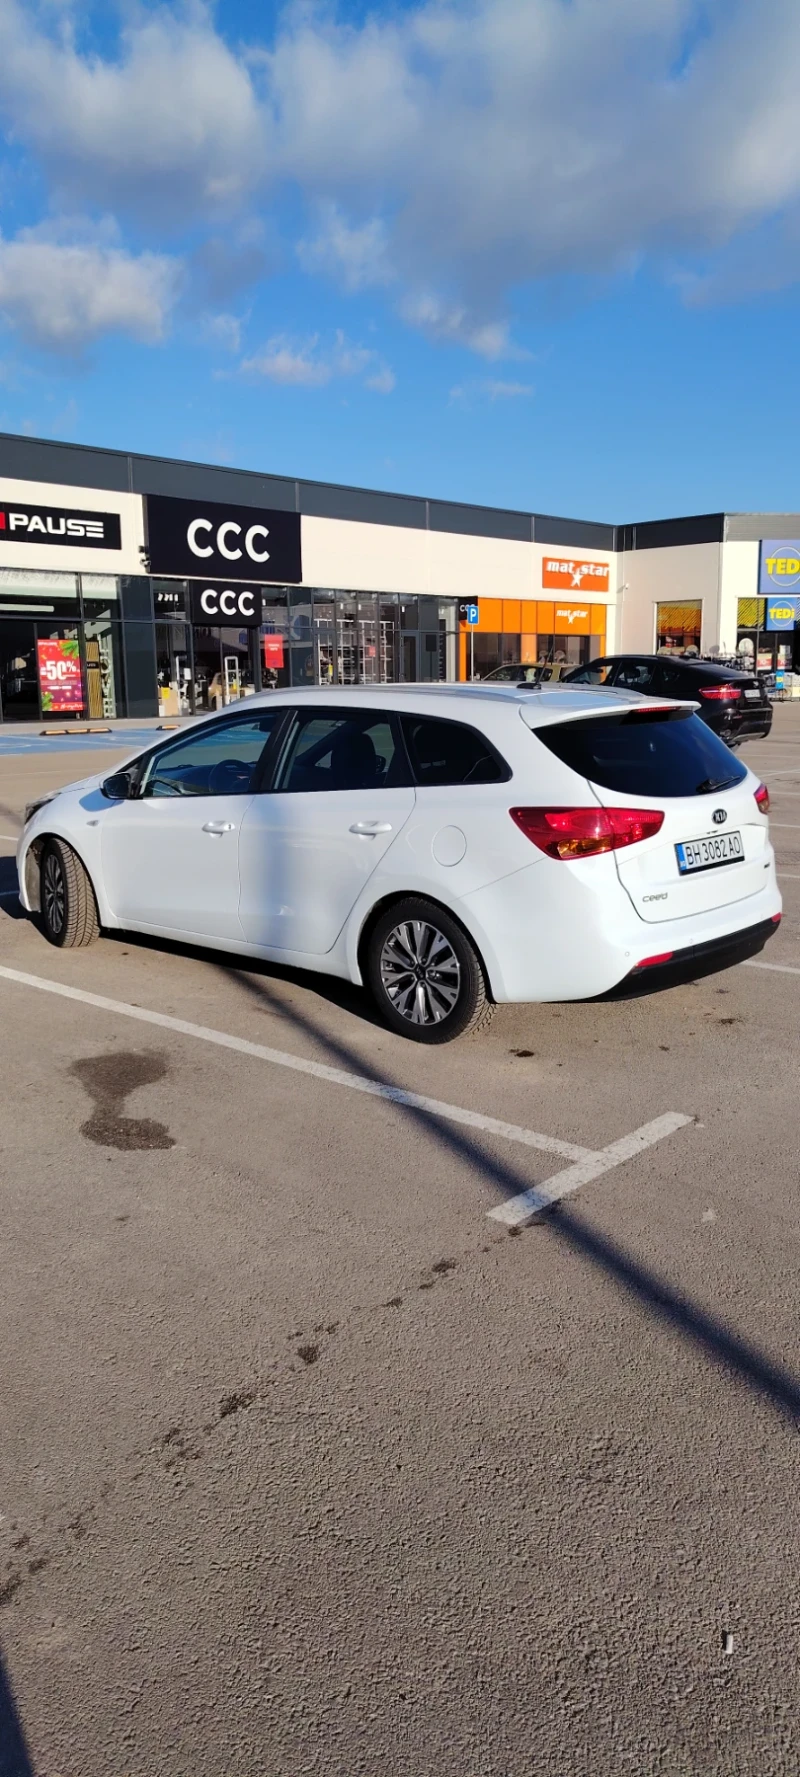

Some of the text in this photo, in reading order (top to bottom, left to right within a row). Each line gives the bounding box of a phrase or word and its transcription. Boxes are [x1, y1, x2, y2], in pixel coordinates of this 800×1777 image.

[9, 513, 104, 538] PAUSE
[187, 518, 270, 562] CCC
[547, 561, 609, 577] mat star
[765, 558, 800, 575] TED
[200, 588, 255, 616] CCC
[470, 608, 477, 622] P
[769, 608, 795, 619] TEDi
[685, 836, 741, 865] BH 3082 AO
